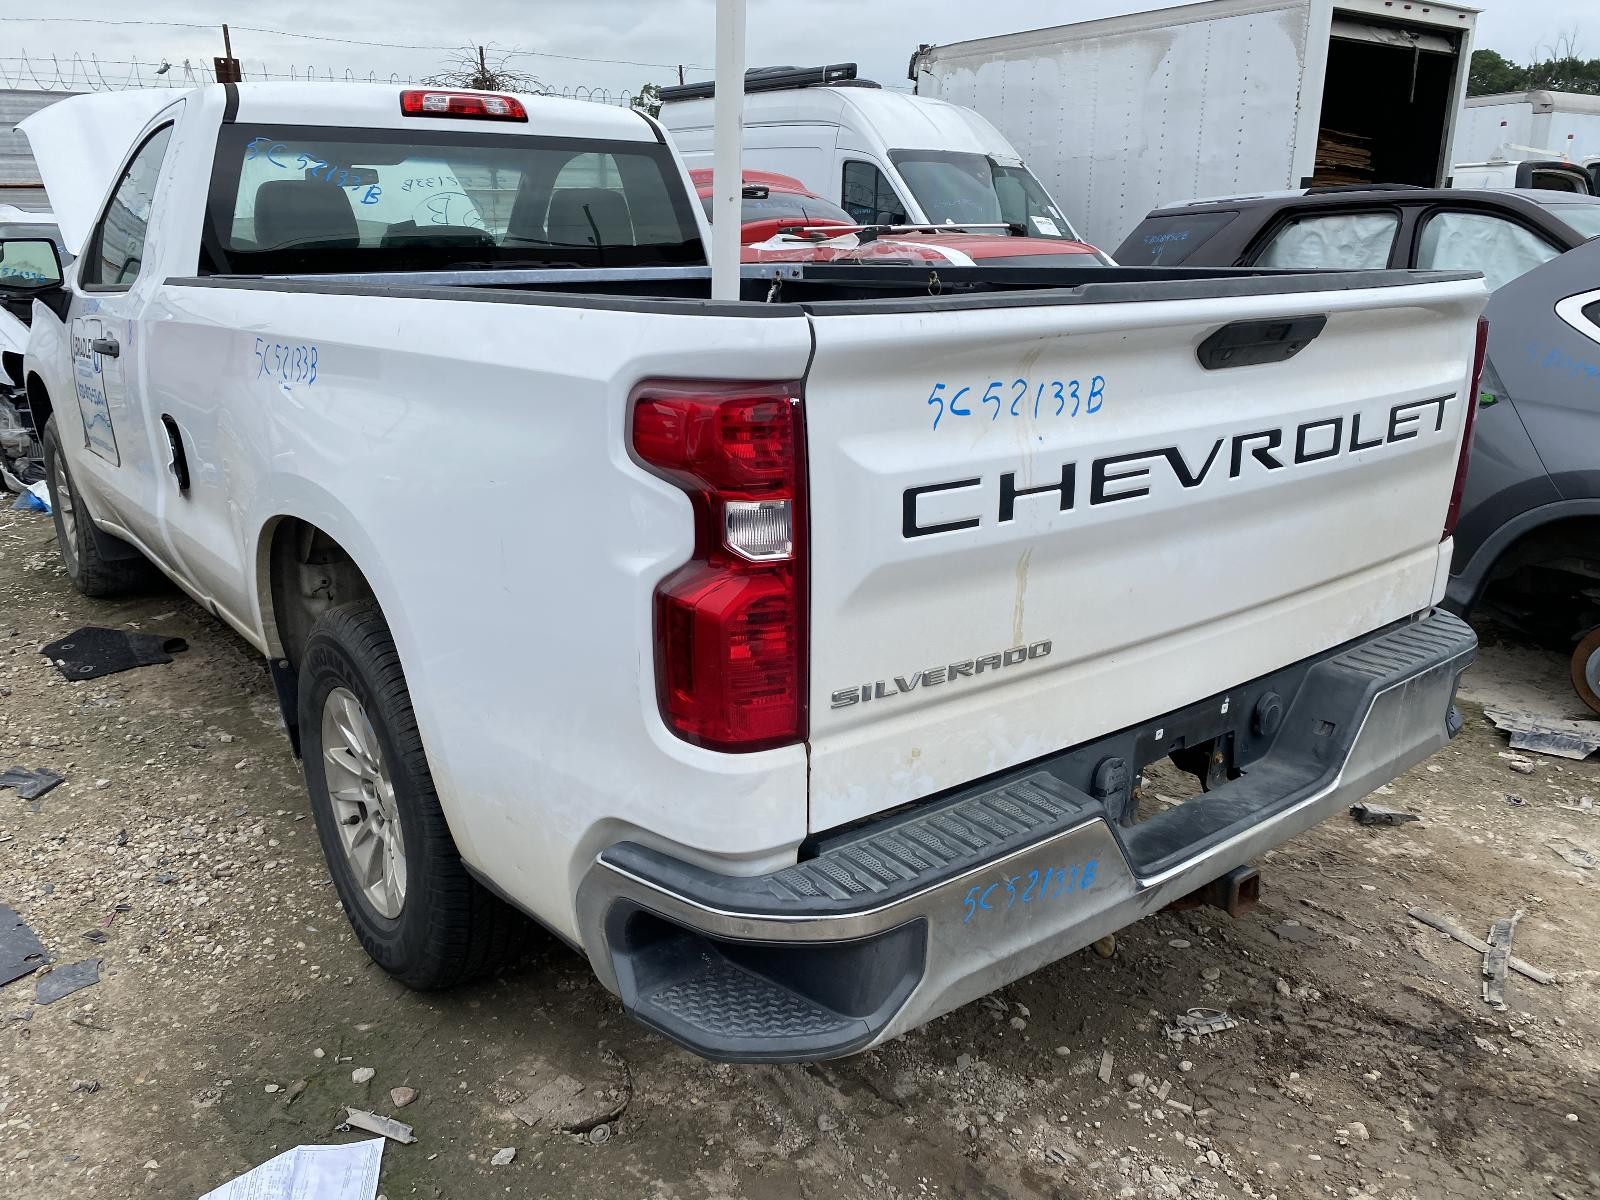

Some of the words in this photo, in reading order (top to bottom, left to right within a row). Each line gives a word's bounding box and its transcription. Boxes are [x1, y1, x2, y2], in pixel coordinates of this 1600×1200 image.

[255, 337, 318, 386] 5C52133B
[927, 375, 1106, 431] 5C52133B
[902, 392, 1457, 539] CHEVROLET
[830, 639, 1052, 710] SILVERADO
